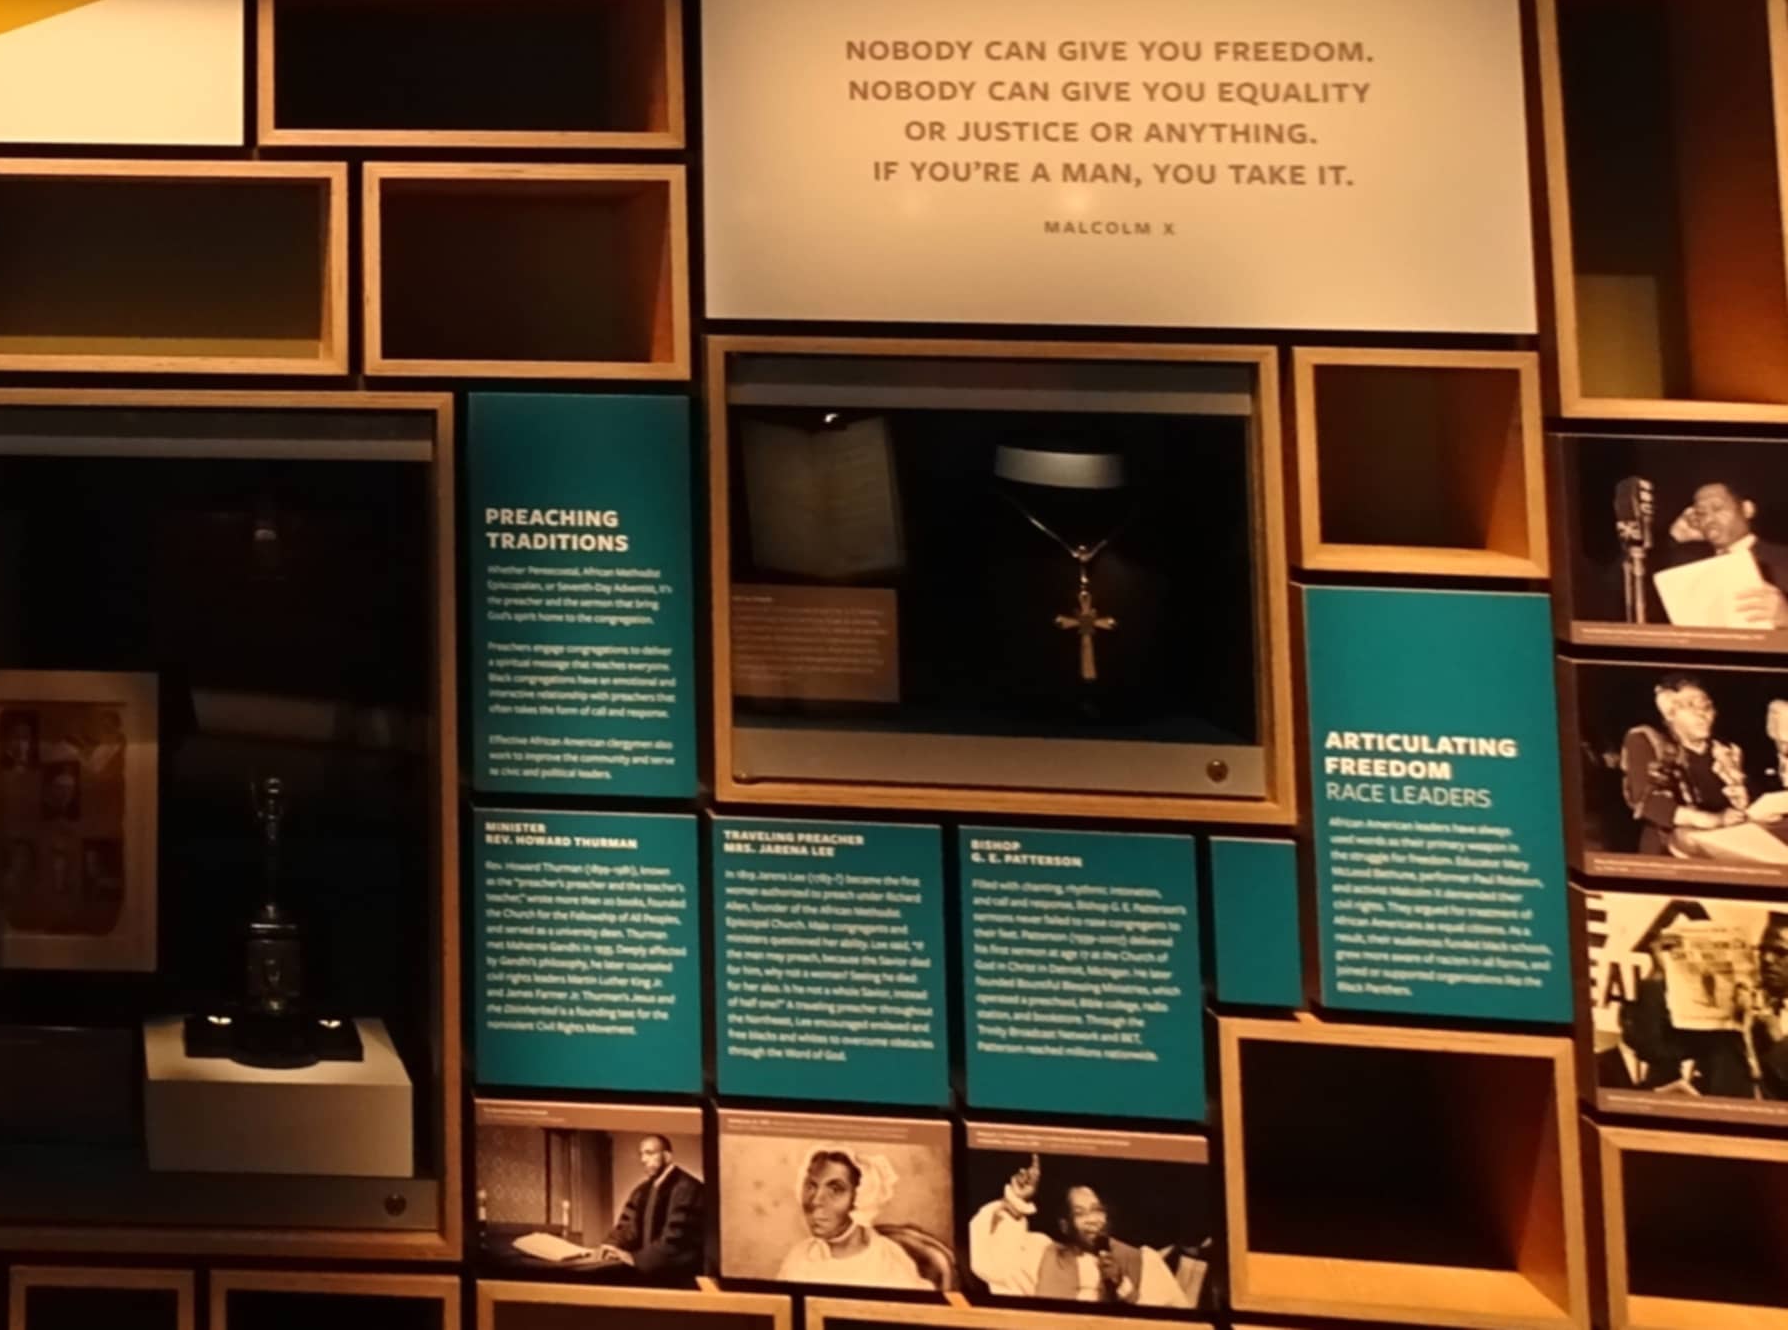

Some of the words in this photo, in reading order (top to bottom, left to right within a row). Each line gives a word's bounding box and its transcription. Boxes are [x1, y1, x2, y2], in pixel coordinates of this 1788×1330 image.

[846, 41, 972, 59] NOBODY
[984, 41, 1046, 60] CAN
[1058, 41, 1126, 60] GIVE
[1139, 41, 1201, 60] YOU
[1214, 41, 1372, 61] FREEDOM.
[849, 81, 975, 100] NOBODY
[988, 81, 1048, 100] CAN
[1061, 82, 1130, 101] GIVE
[1142, 82, 1204, 101] YOU
[1218, 82, 1369, 104] EQUALITY
[905, 121, 945, 140] OR
[957, 121, 1078, 141] JUSTICE
[1090, 122, 1131, 141] OR
[1144, 123, 1316, 143] ANYTHING.
[874, 161, 898, 180] IF
[910, 162, 1019, 181] YOU'RE
[1031, 163, 1050, 181] A
[1062, 163, 1141, 185] MAN,
[1153, 164, 1215, 183] YOU
[1228, 164, 1305, 184] TAKE
[1318, 165, 1352, 185] IT.
[1044, 221, 1150, 234] MALCOLM
[1164, 223, 1174, 234] X
[486, 509, 617, 526] PREACHING
[486, 533, 628, 550] TRADITIONS
[1325, 732, 1516, 755] ARTICULATING
[1325, 757, 1450, 778] FREEDOM
[1326, 782, 1384, 802] RACE
[1390, 786, 1490, 806] LEADERS
[485, 823, 546, 832] MINISTER
[485, 834, 513, 843] REV.
[515, 836, 571, 845] HOWARD
[574, 837, 637, 847] THURMAN
[724, 830, 794, 841] TRAVELING
[796, 833, 864, 844] PREACHER
[970, 840, 1020, 850] BISHOP
[723, 843, 755, 852] MRS.
[759, 845, 808, 854] JARENA
[810, 846, 834, 856] LEE
[970, 852, 985, 862] G.
[988, 853, 1001, 862] E.
[1003, 854, 1082, 865] PATTERSON
